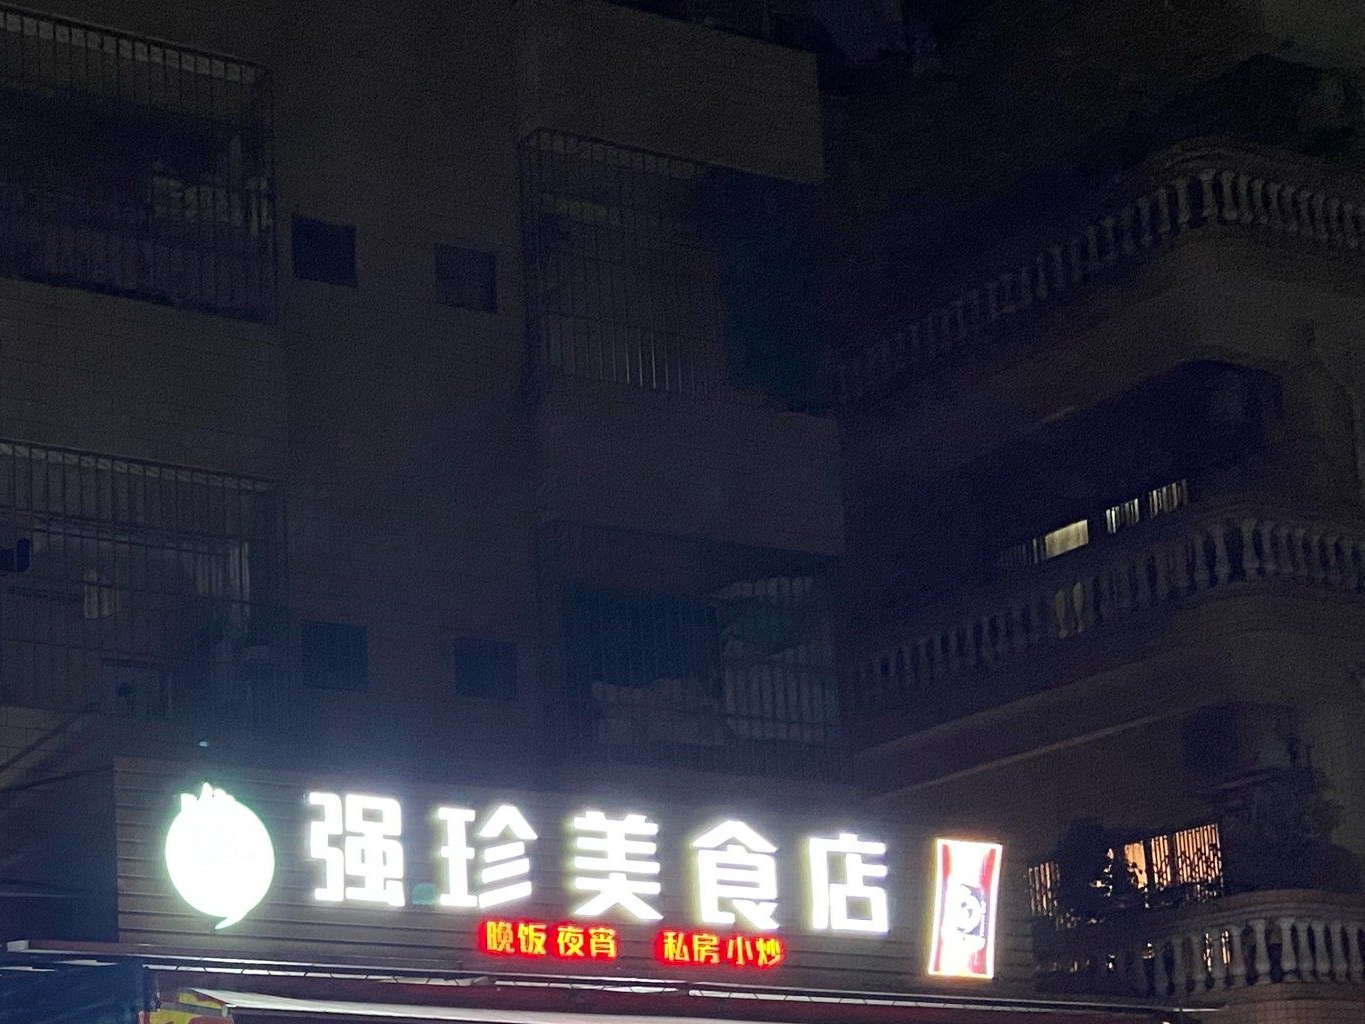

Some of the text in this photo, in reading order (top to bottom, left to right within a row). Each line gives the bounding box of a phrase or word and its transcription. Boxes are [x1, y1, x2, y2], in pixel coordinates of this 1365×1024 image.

[307, 791, 890, 933] 强珍美食店
[485, 921, 782, 967] 晚饭夜宵 私房小炒
